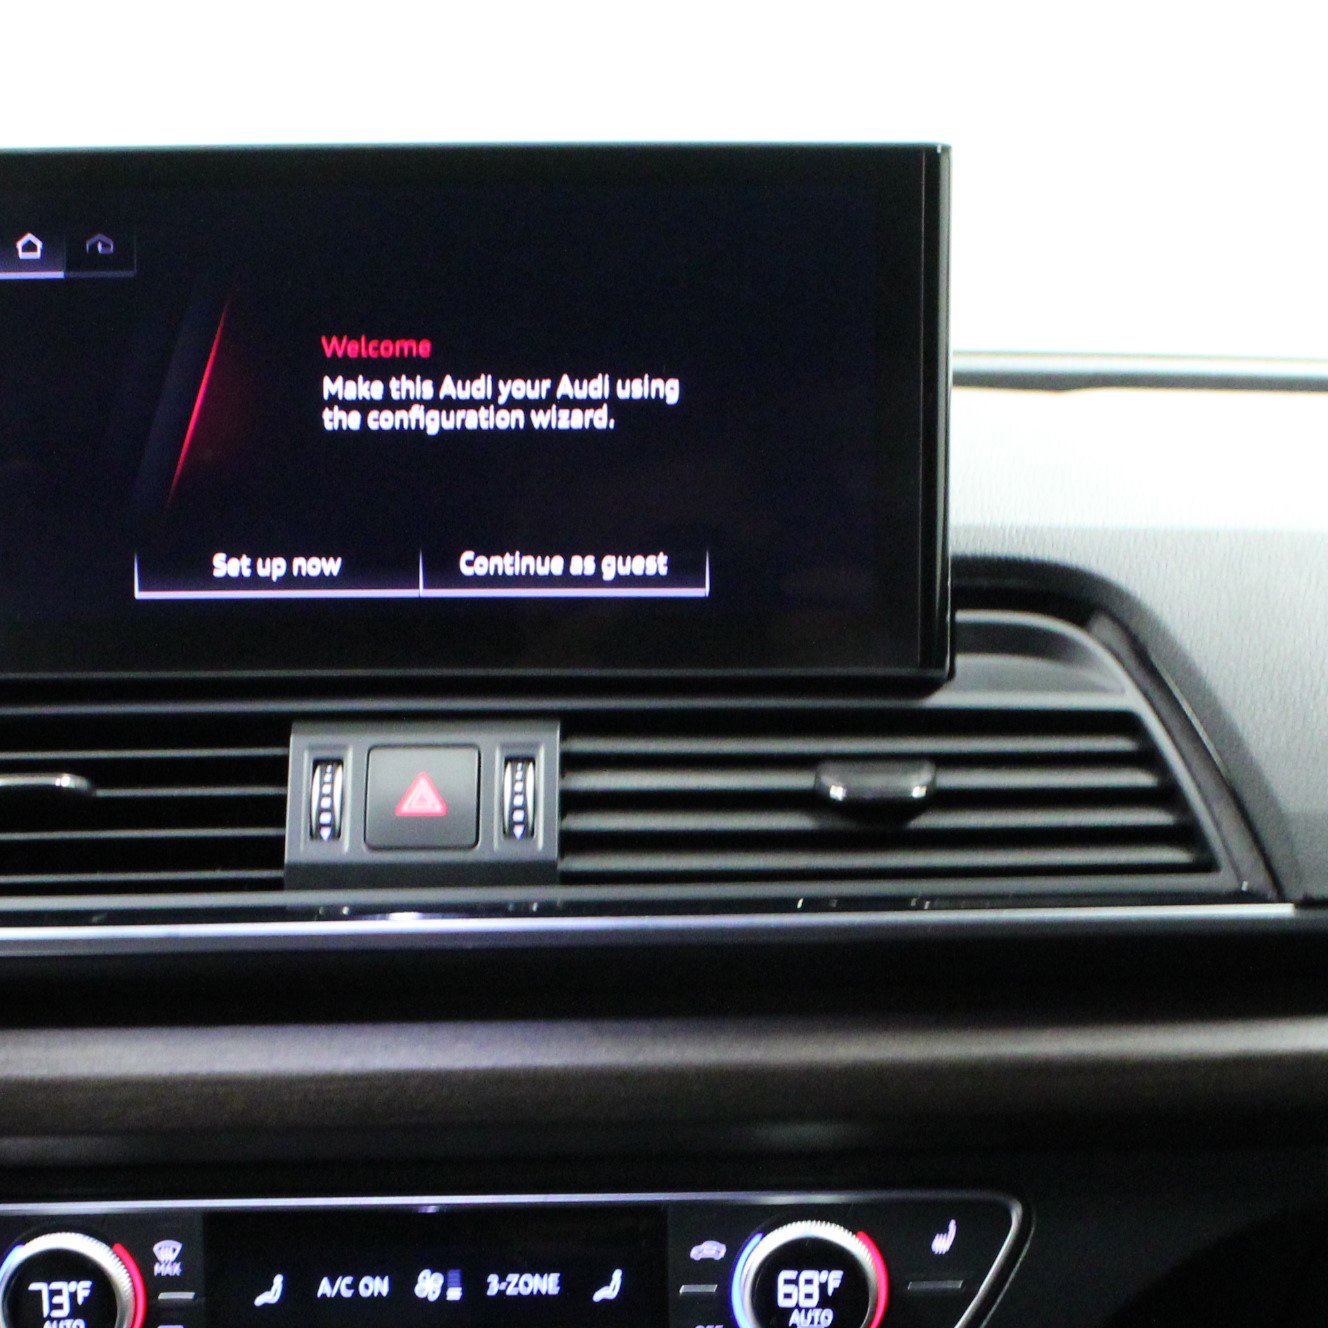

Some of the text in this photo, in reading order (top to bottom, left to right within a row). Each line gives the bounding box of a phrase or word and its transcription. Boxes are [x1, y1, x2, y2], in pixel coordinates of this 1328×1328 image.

[321, 334, 432, 358] Welcome
[322, 373, 680, 405] Make this Audi your Audi using
[322, 402, 615, 436] the configuration wizard.
[212, 552, 342, 582] Set up now
[459, 550, 669, 581] Continue as guest
[153, 1262, 183, 1277] MAX
[316, 1275, 390, 1299] A/C ON
[486, 1272, 561, 1297] 3-ZONE
[789, 1307, 834, 1328] AUTO
